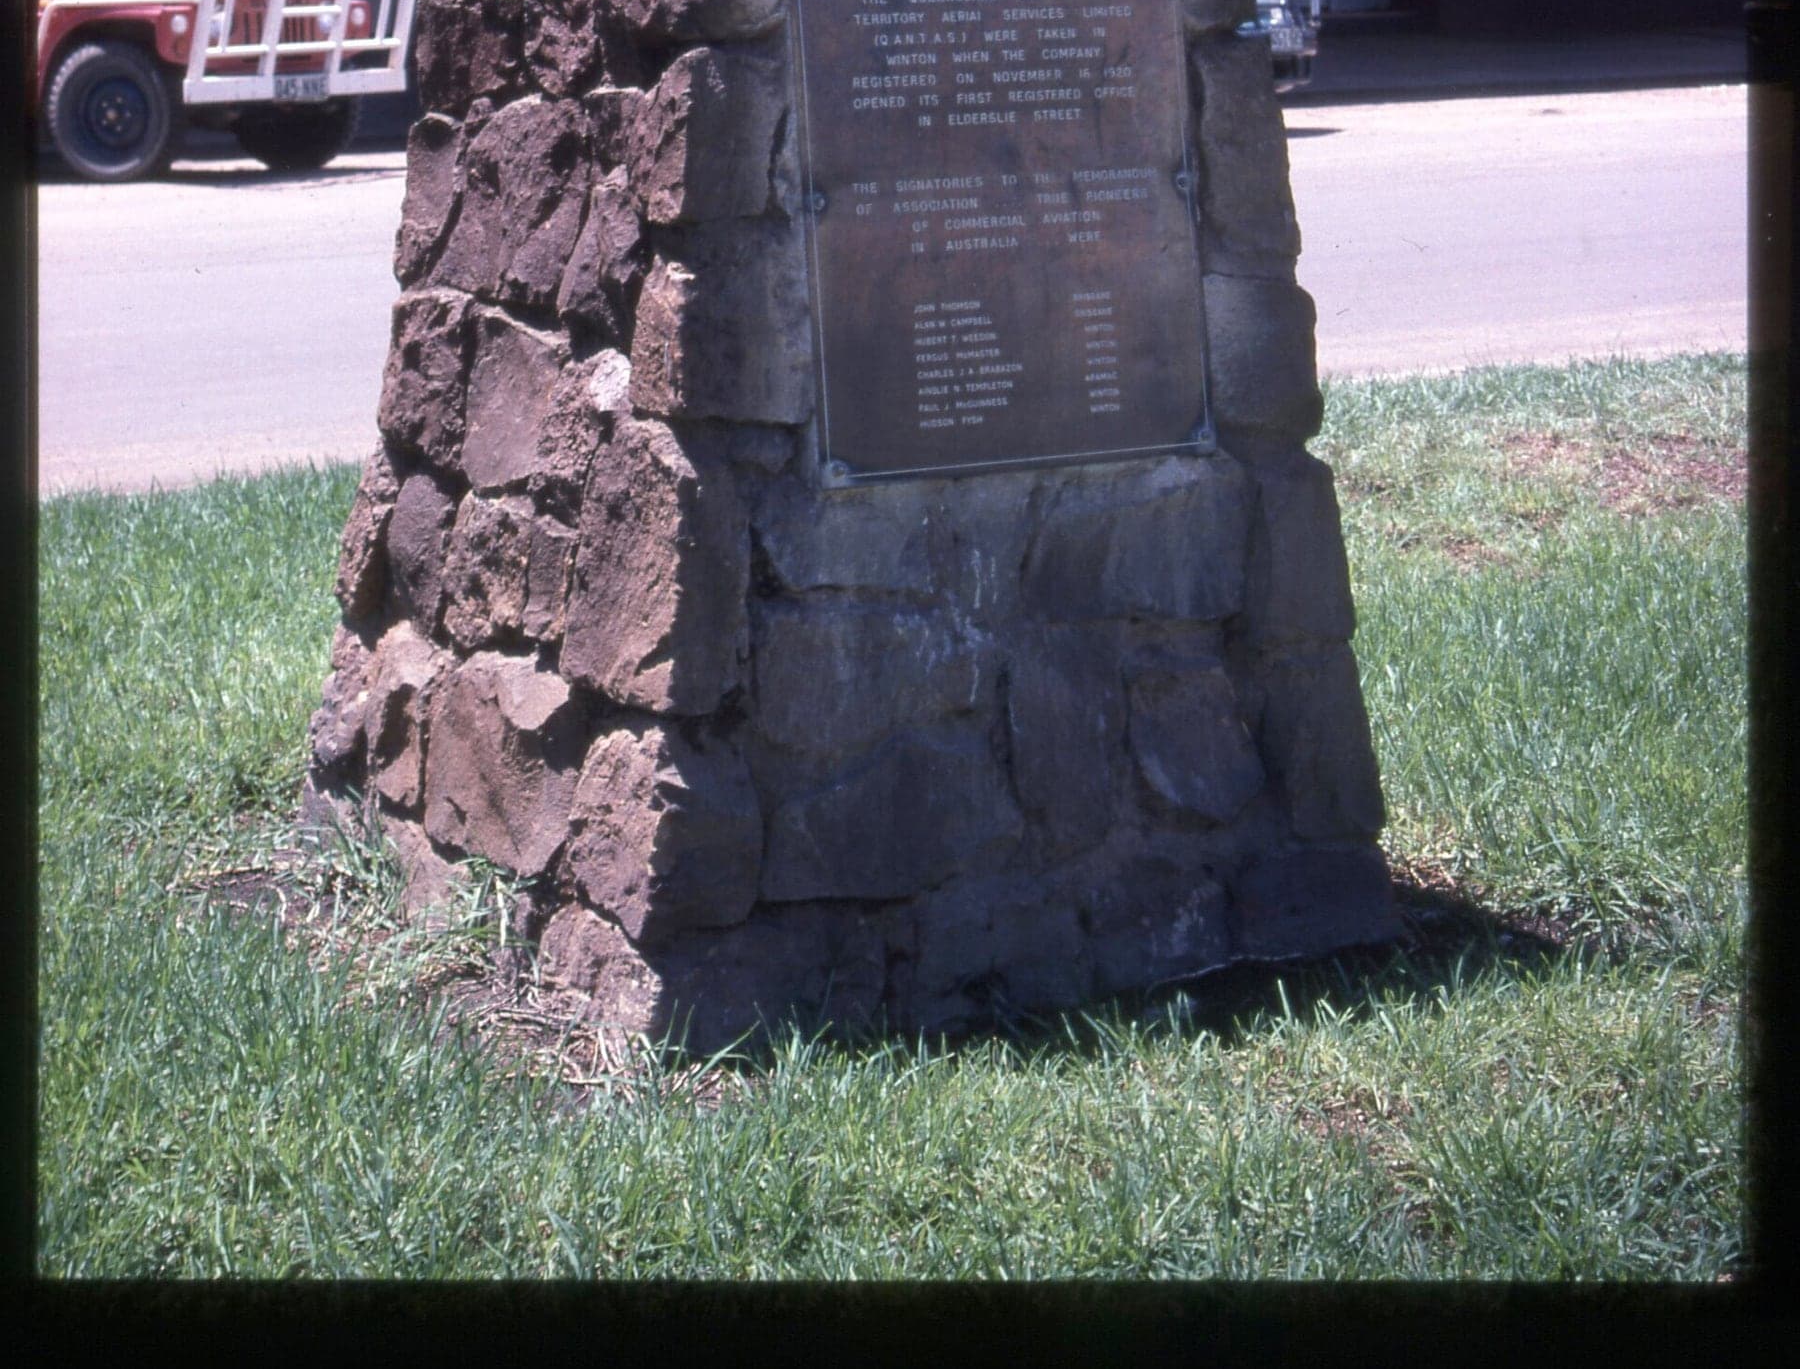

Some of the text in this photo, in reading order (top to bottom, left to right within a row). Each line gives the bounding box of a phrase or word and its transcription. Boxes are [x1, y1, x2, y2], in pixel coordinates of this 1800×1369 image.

[854, 14, 924, 25] TERRITORY
[1003, 8, 1064, 20] SERVICES
[1083, 6, 1132, 18] LIMITED
[985, 30, 1017, 41] WERE
[1037, 29, 1075, 39] TAKEN
[1094, 28, 1105, 38] IN
[887, 47, 1101, 66] WINTON WHEN THE COMPANY
[853, 74, 936, 89] REGISTERED
[957, 73, 973, 84] ON
[993, 70, 1061, 83] NOVEMBER
[854, 97, 904, 109] OPENED
[919, 94, 938, 106] ITS
[957, 93, 992, 105] FIRST
[1009, 89, 1081, 102] REGISTERED
[919, 109, 1080, 126] IN ELDERSLIE STREET
[853, 183, 878, 195] THE
[896, 176, 984, 191] SIGNATORIES
[1002, 175, 1017, 186] TO
[856, 204, 873, 215] OF
[893, 198, 978, 213] ASSOCIATION
[1037, 192, 1068, 205] TRUE
[913, 211, 1100, 232] OF COMMERCIAL AVIATION
[912, 231, 1101, 253] IN AUSTRALIA WERE
